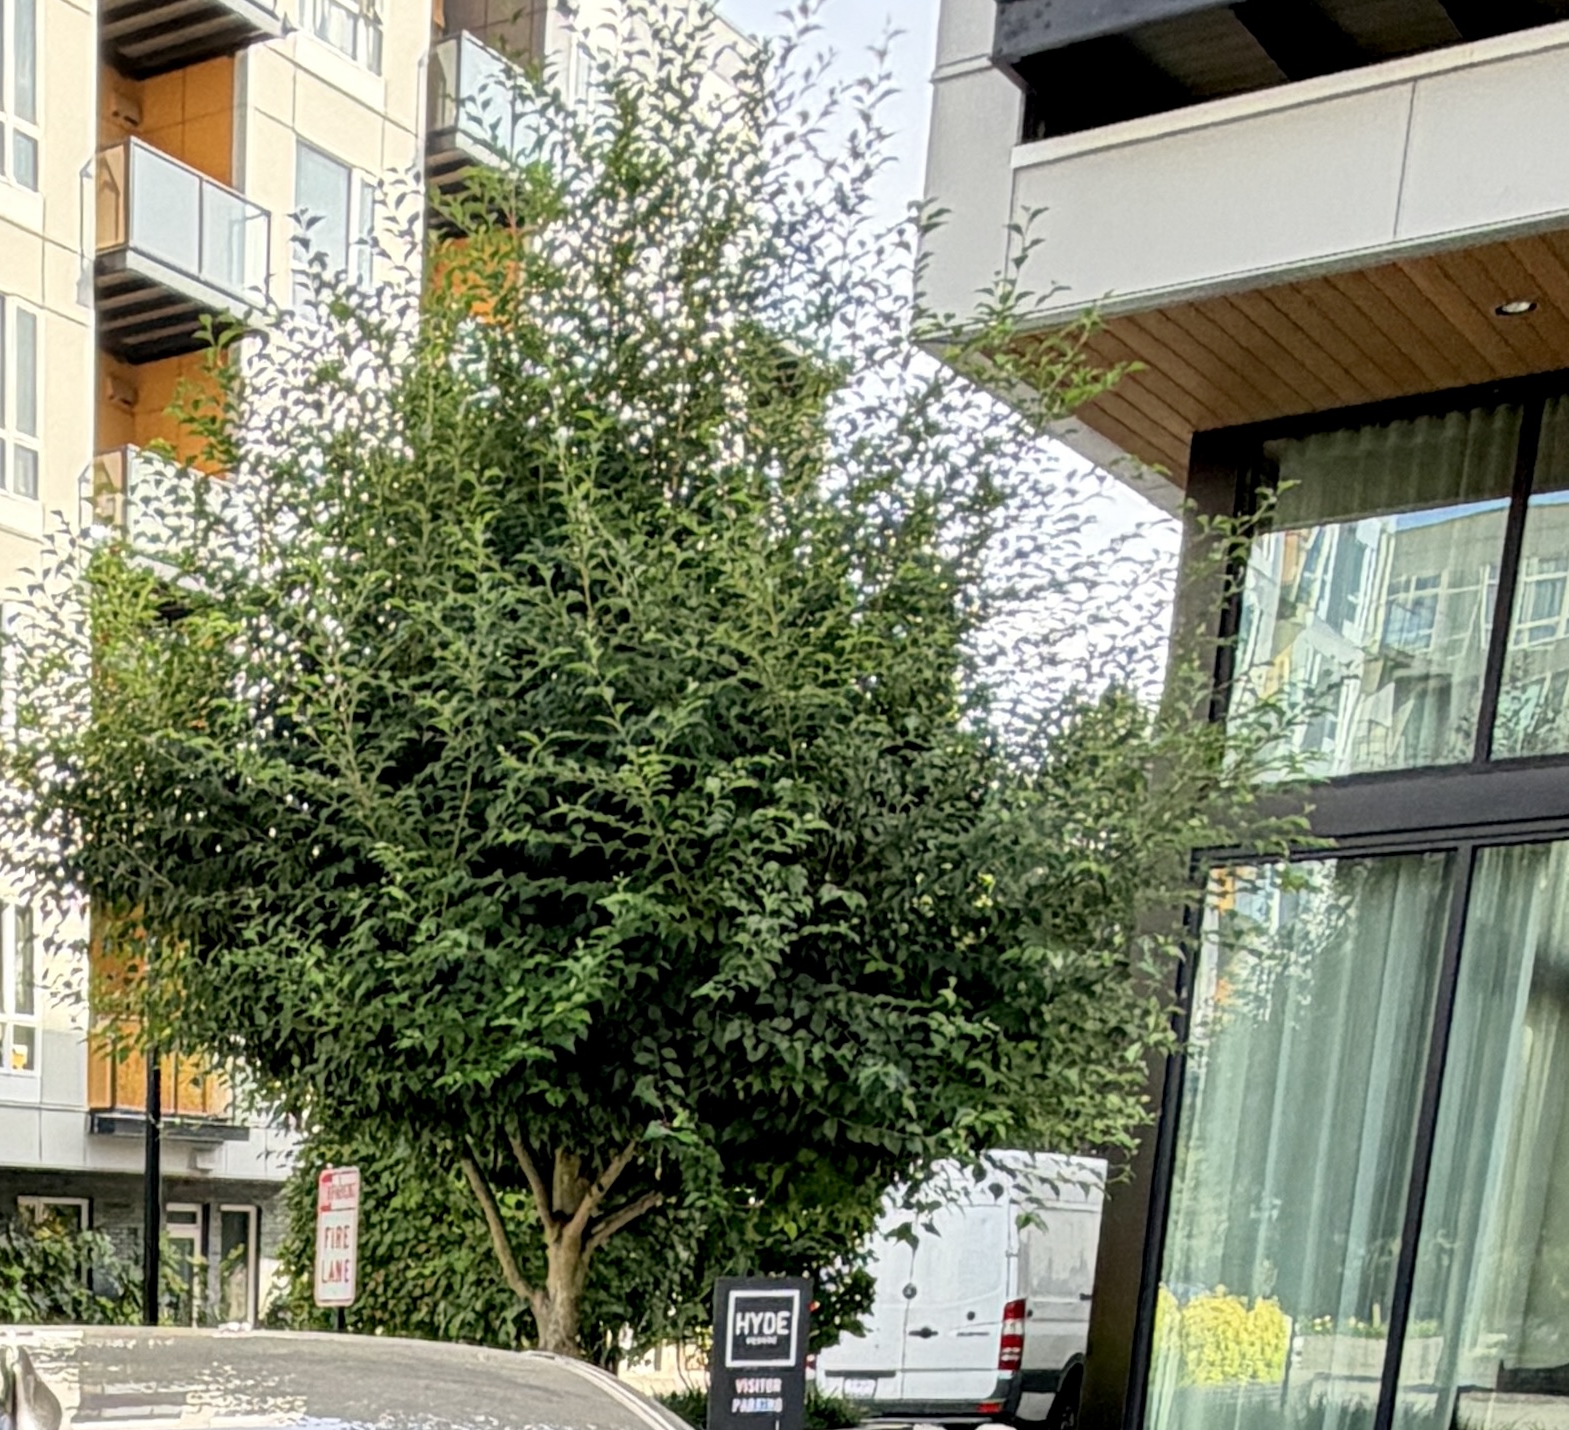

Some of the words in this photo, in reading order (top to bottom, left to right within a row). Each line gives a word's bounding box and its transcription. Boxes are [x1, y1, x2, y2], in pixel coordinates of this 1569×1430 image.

[325, 1224, 350, 1249] FIRE
[321, 1259, 350, 1283] LANE
[735, 1310, 792, 1336] HYDE
[735, 1378, 783, 1395] VISITOR
